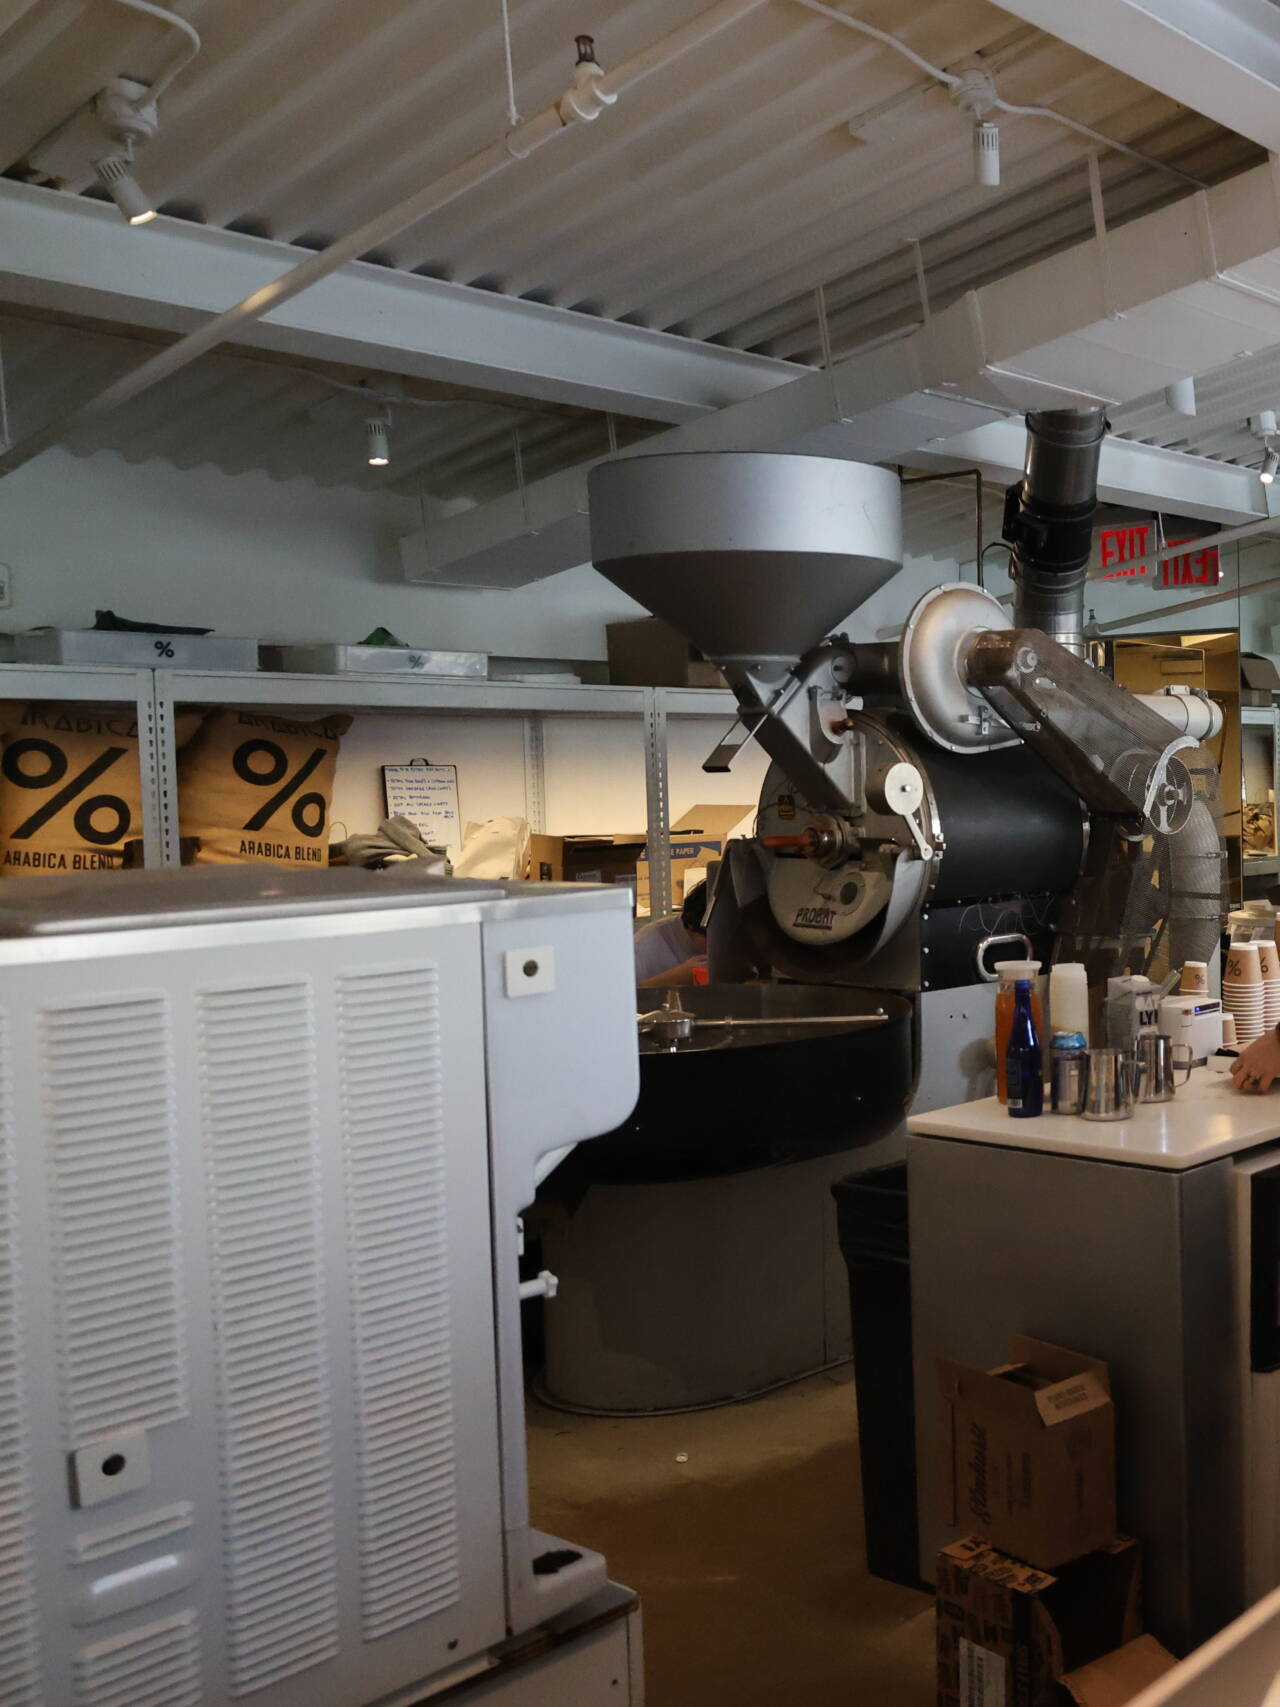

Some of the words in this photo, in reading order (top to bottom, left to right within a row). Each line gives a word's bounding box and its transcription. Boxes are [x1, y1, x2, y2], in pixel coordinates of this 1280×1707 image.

[1100, 526, 1149, 578] EXIT
[3, 850, 67, 870] ARABICA
[72, 853, 115, 871] BLEND
[239, 839, 291, 860] ARABICA
[294, 846, 322, 862] BLEND
[1139, 1010, 1158, 1026] LY!
